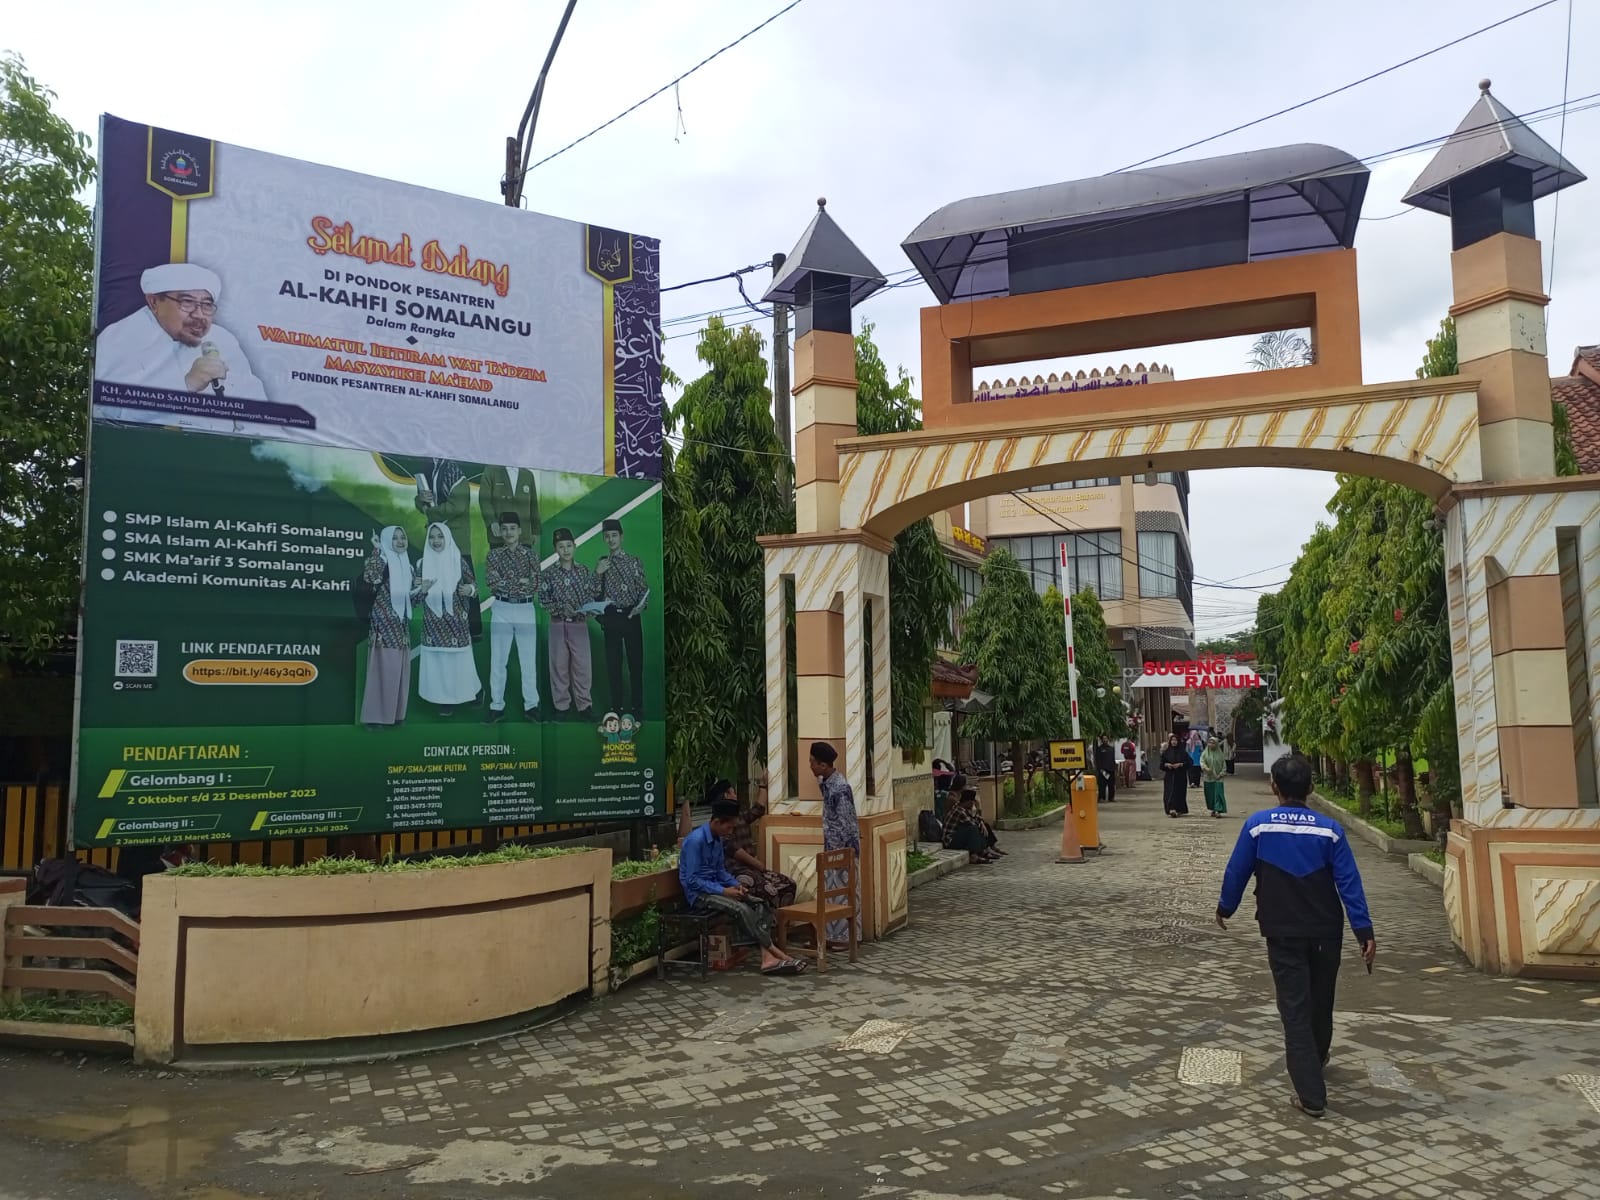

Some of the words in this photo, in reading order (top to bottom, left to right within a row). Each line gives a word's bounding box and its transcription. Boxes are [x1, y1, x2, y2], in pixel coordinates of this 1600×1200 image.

[307, 216, 415, 268] Selamat
[421, 239, 509, 297] Datang
[324, 269, 340, 282] DI
[345, 272, 412, 295] PONDOK
[416, 286, 494, 310] PESANTREN
[279, 279, 387, 312] AL-KAHFI
[395, 300, 531, 336] SOMALANGU
[366, 315, 407, 331] Dalam
[410, 322, 456, 339] Rangka
[258, 324, 367, 356] WALIMATUL
[370, 342, 446, 368] IHTIRAM
[324, 354, 426, 383] MASYAYIKH
[102, 385, 121, 395] KH.
[125, 388, 164, 400] AHMAD
[167, 393, 200, 404] SADID
[202, 398, 244, 410] JAUHARI
[291, 370, 338, 386] PONDOK
[342, 377, 406, 396] PESANTREN
[408, 387, 456, 402] AL-KAHFI
[458, 394, 520, 410] SOMALANGU
[126, 512, 162, 525] SMP
[166, 516, 210, 530] Islam
[214, 520, 277, 534] Al-Kahfi
[280, 524, 364, 541] Somalangu
[124, 532, 162, 545] SMA
[166, 535, 210, 548] Islam
[214, 538, 277, 552] Al-Kahfi
[280, 541, 364, 558] Somalangu
[124, 552, 160, 564] SMK
[166, 554, 220, 568] Ma'arif
[225, 556, 234, 568] 3
[238, 558, 324, 574] Somalangu
[122, 570, 198, 585] Akademi
[202, 574, 286, 589] Komunitas
[290, 578, 350, 592] Al-Kahfi
[181, 642, 214, 654] LINK
[219, 642, 320, 656] PENDAFTARAN
[192, 666, 312, 678] https://bit.ly/46y3qQh
[1143, 661, 1227, 676] SUGENG
[1185, 674, 1260, 690] RAWUH
[123, 745, 240, 762] PENDAFTARAN
[424, 746, 470, 756] CONTACK
[472, 744, 510, 756] PERSON
[130, 773, 215, 787] Gelombang
[128, 796, 134, 804] 2
[138, 794, 188, 804] Oktober
[192, 792, 208, 803] s/d
[212, 792, 226, 801] 23
[229, 790, 288, 800] Desember
[290, 789, 316, 798] 2023
[118, 820, 179, 832] Gelombang
[270, 812, 324, 823] Gelombang
[1271, 813, 1316, 822] POWAD
[124, 836, 154, 844] Januari
[158, 835, 170, 843] s/d
[274, 827, 291, 836] April
